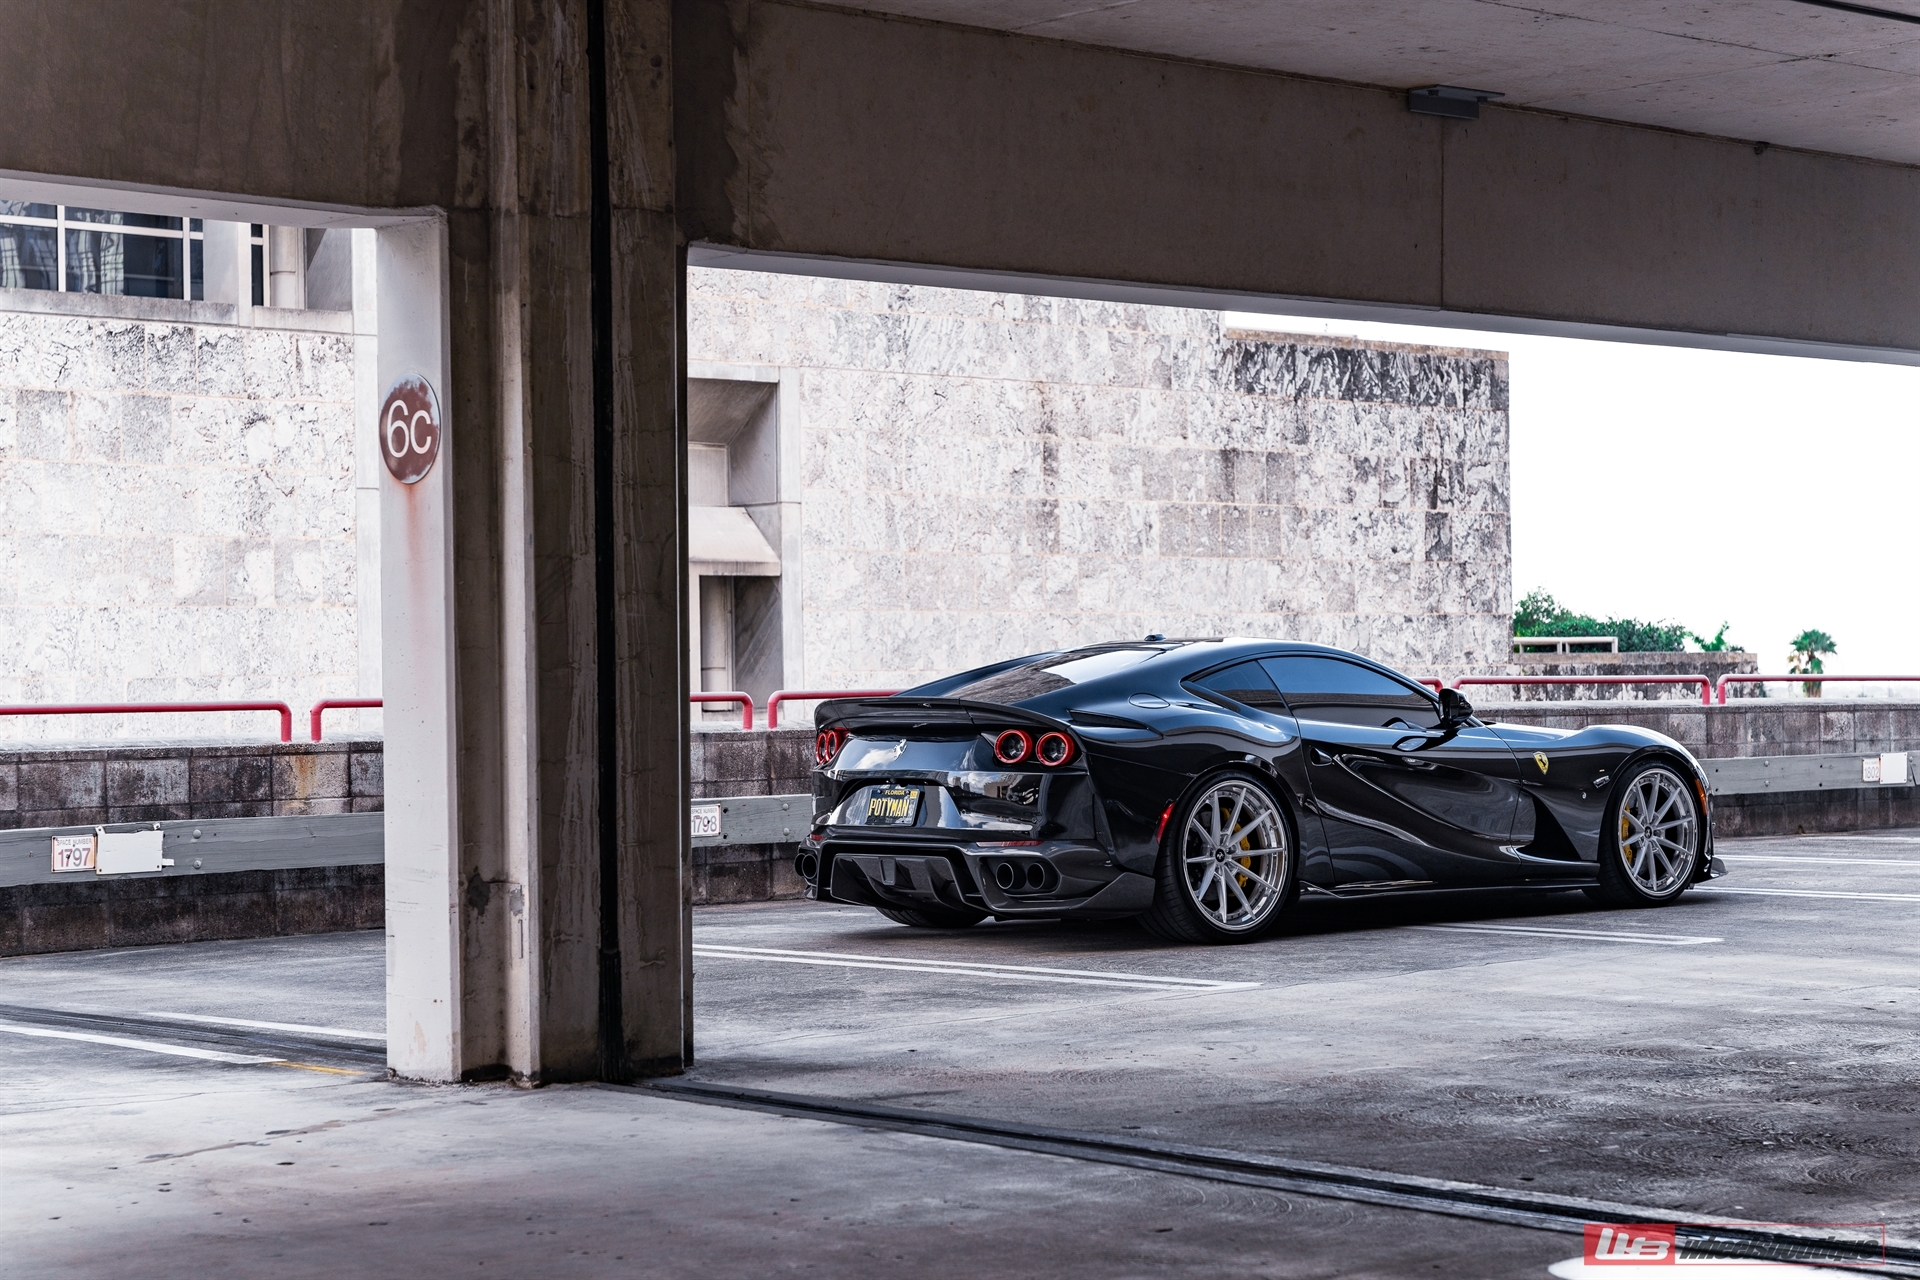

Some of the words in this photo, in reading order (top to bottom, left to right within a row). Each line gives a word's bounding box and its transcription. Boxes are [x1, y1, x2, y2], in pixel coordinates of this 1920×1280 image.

[868, 797, 910, 817] POTYMAN
[691, 815, 717, 833] 1798
[58, 847, 91, 867] 1797
